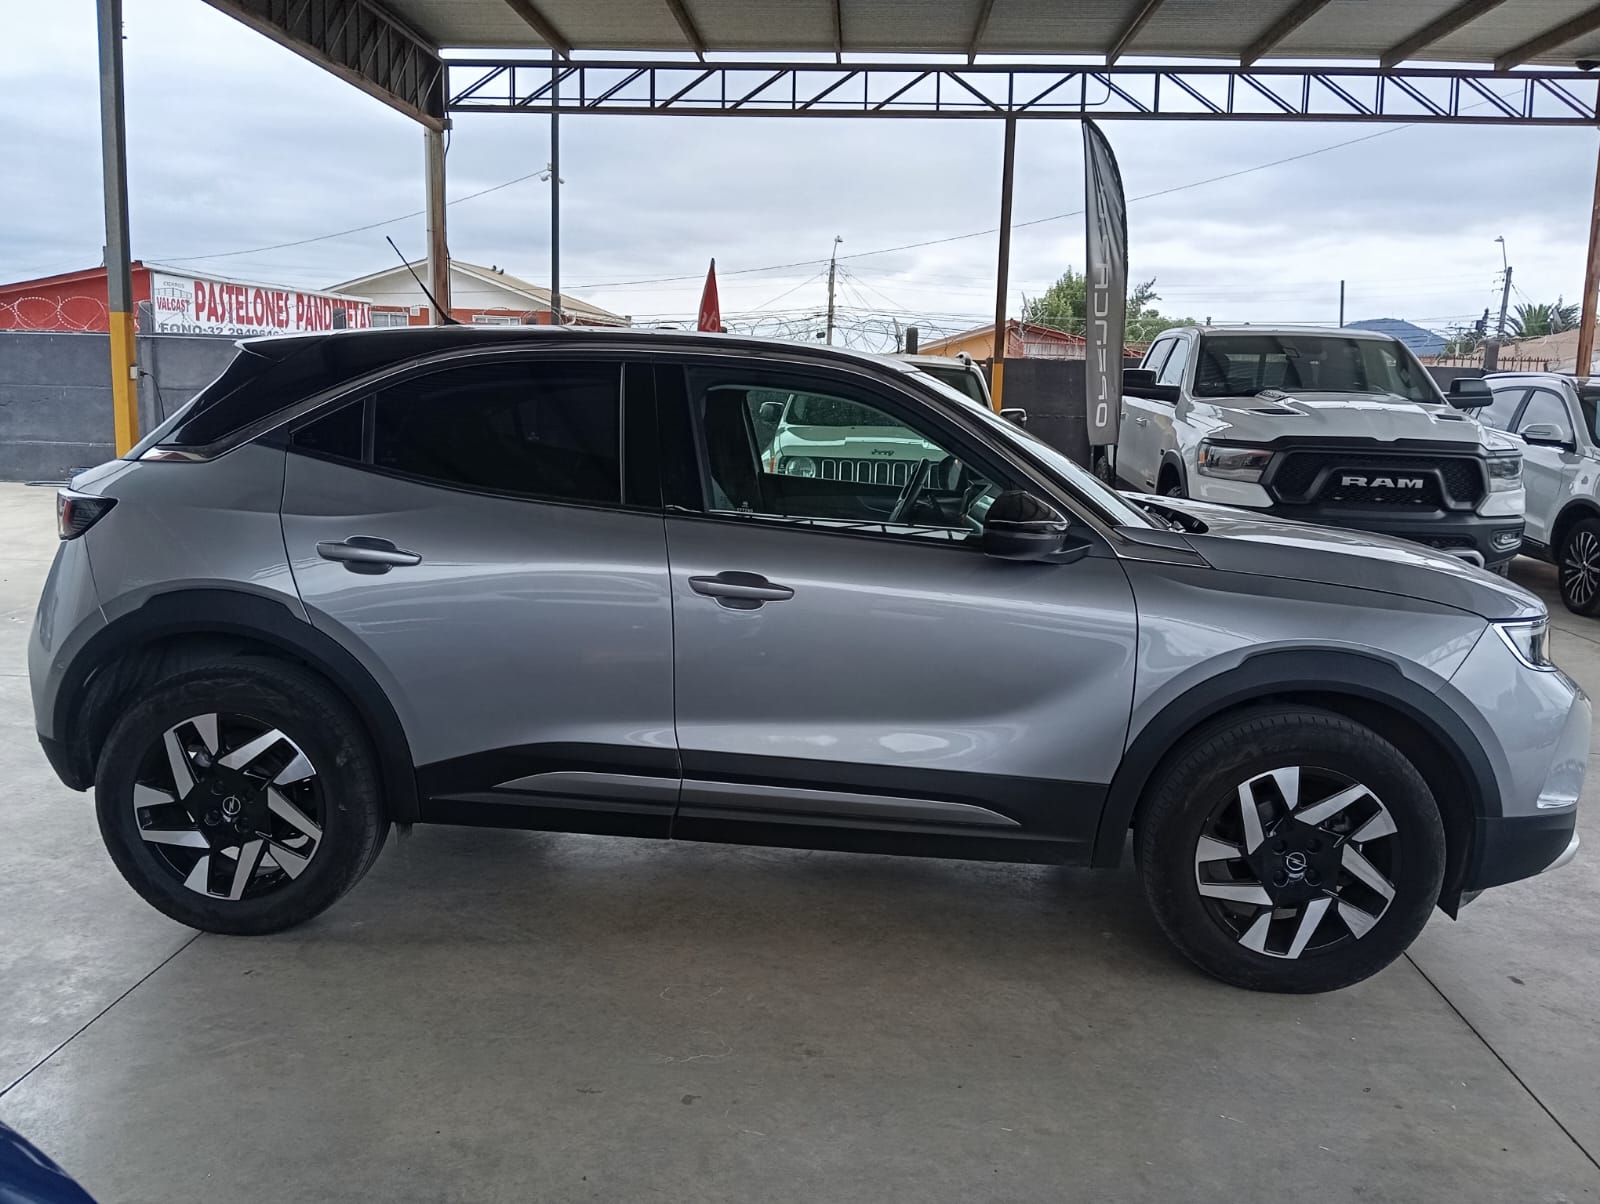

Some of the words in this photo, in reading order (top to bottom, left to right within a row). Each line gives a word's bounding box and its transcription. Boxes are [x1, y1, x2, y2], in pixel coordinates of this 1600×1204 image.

[156, 296, 190, 312] VALCAST
[194, 280, 289, 329] PASTELONES
[296, 293, 372, 331] PANDETAS
[1341, 476, 1424, 489] RAM
